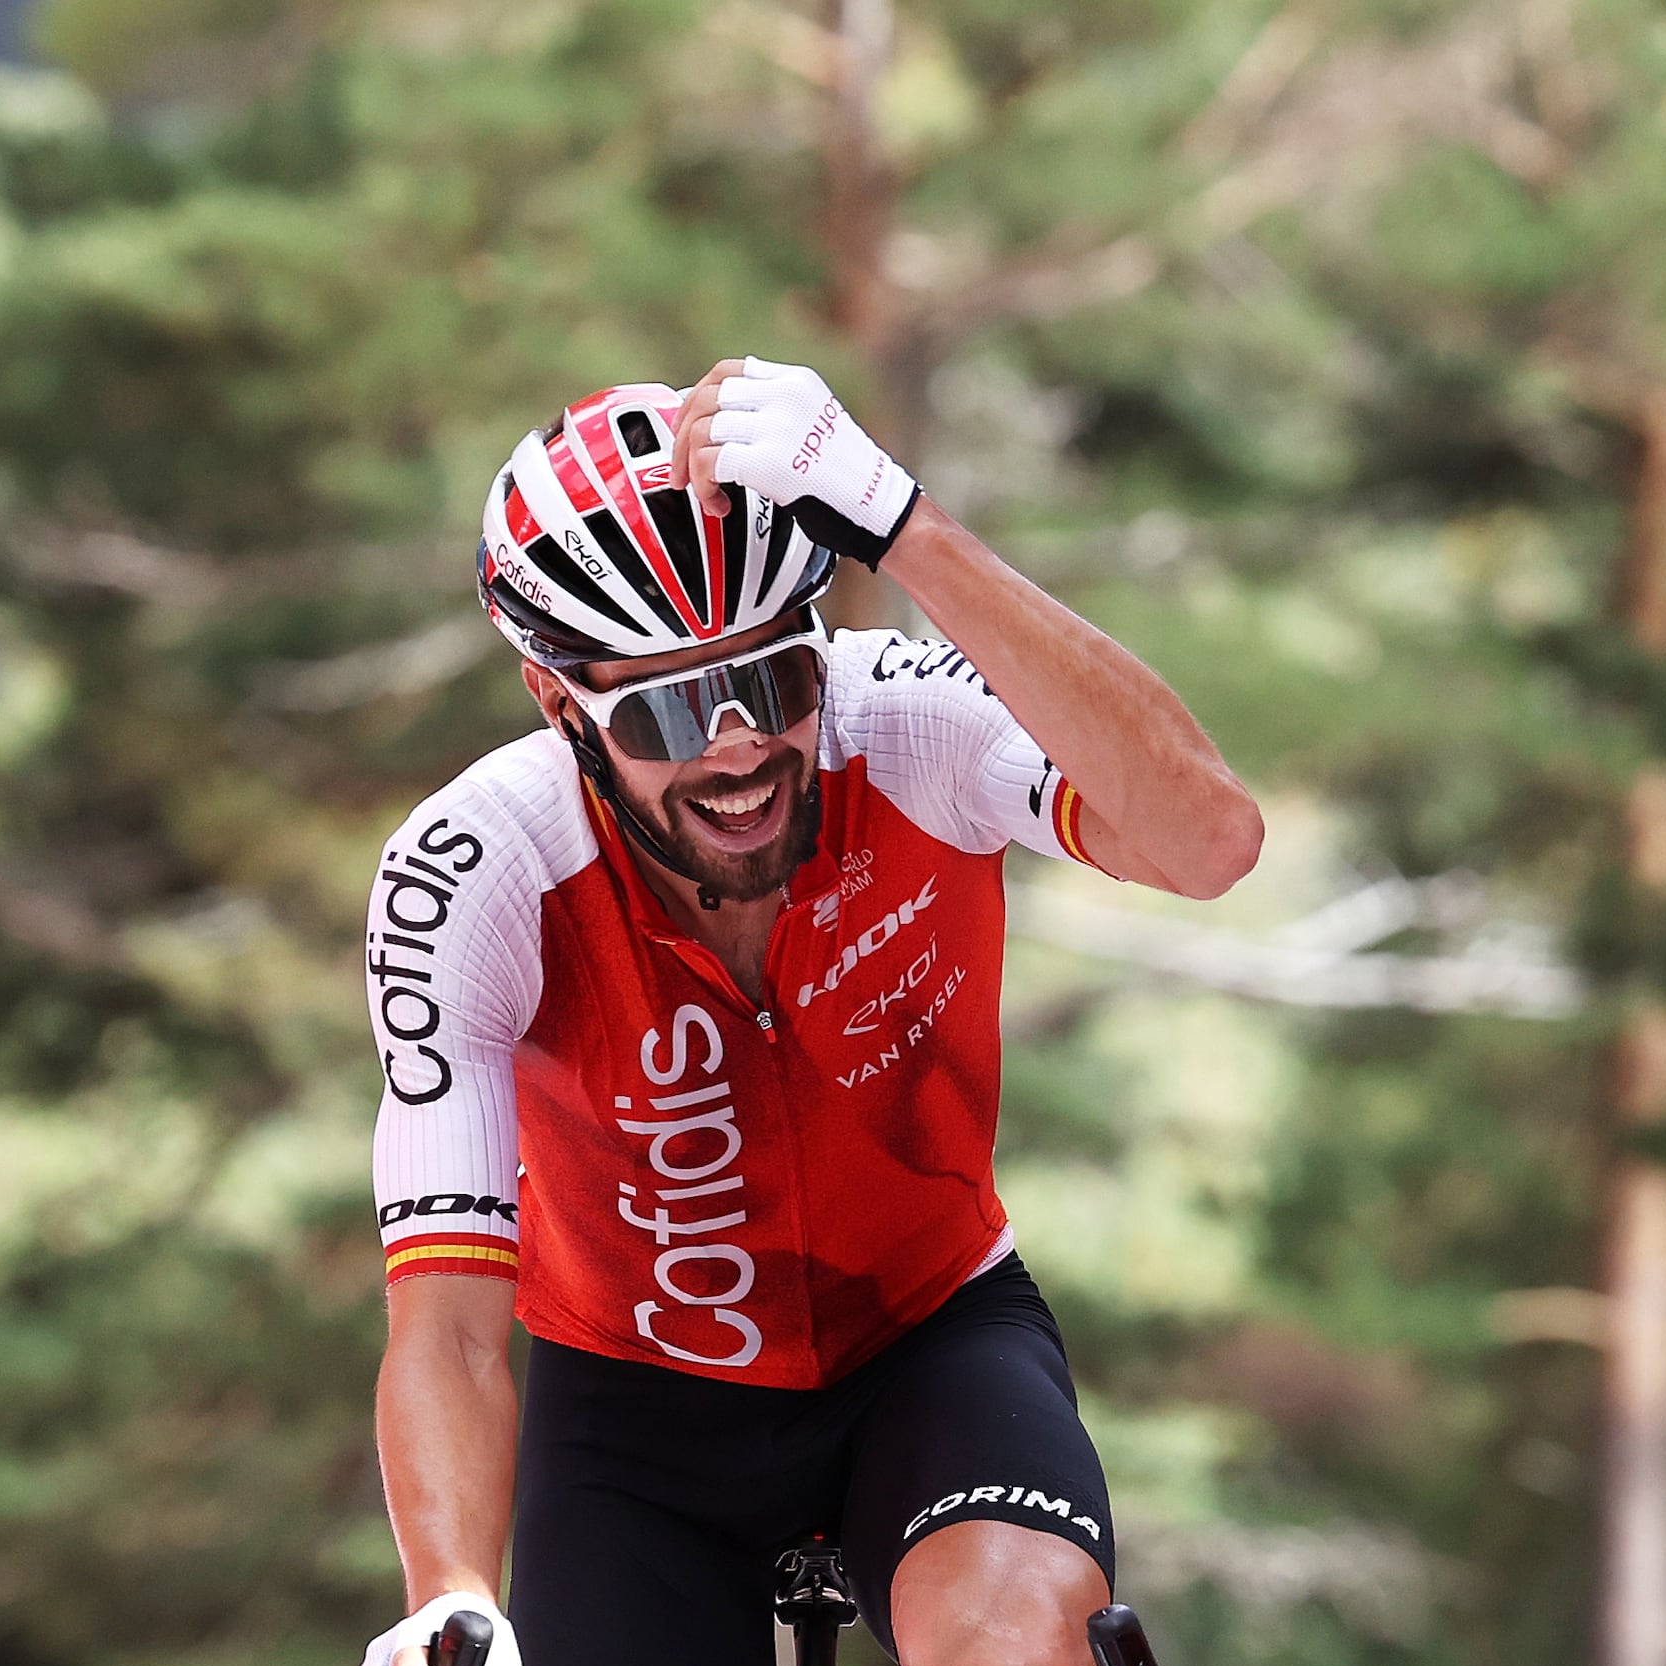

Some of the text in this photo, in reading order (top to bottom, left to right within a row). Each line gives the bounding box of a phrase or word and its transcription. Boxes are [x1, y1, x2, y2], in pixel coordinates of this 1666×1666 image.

[496, 543, 552, 613] Cofidis
[369, 818, 483, 1105] Cofidis
[797, 873, 938, 1007] LOOK
[836, 965, 966, 1089] VAN RYSEL
[614, 1003, 763, 1367] Cofidis
[903, 1485, 1100, 1541] CORIMA
